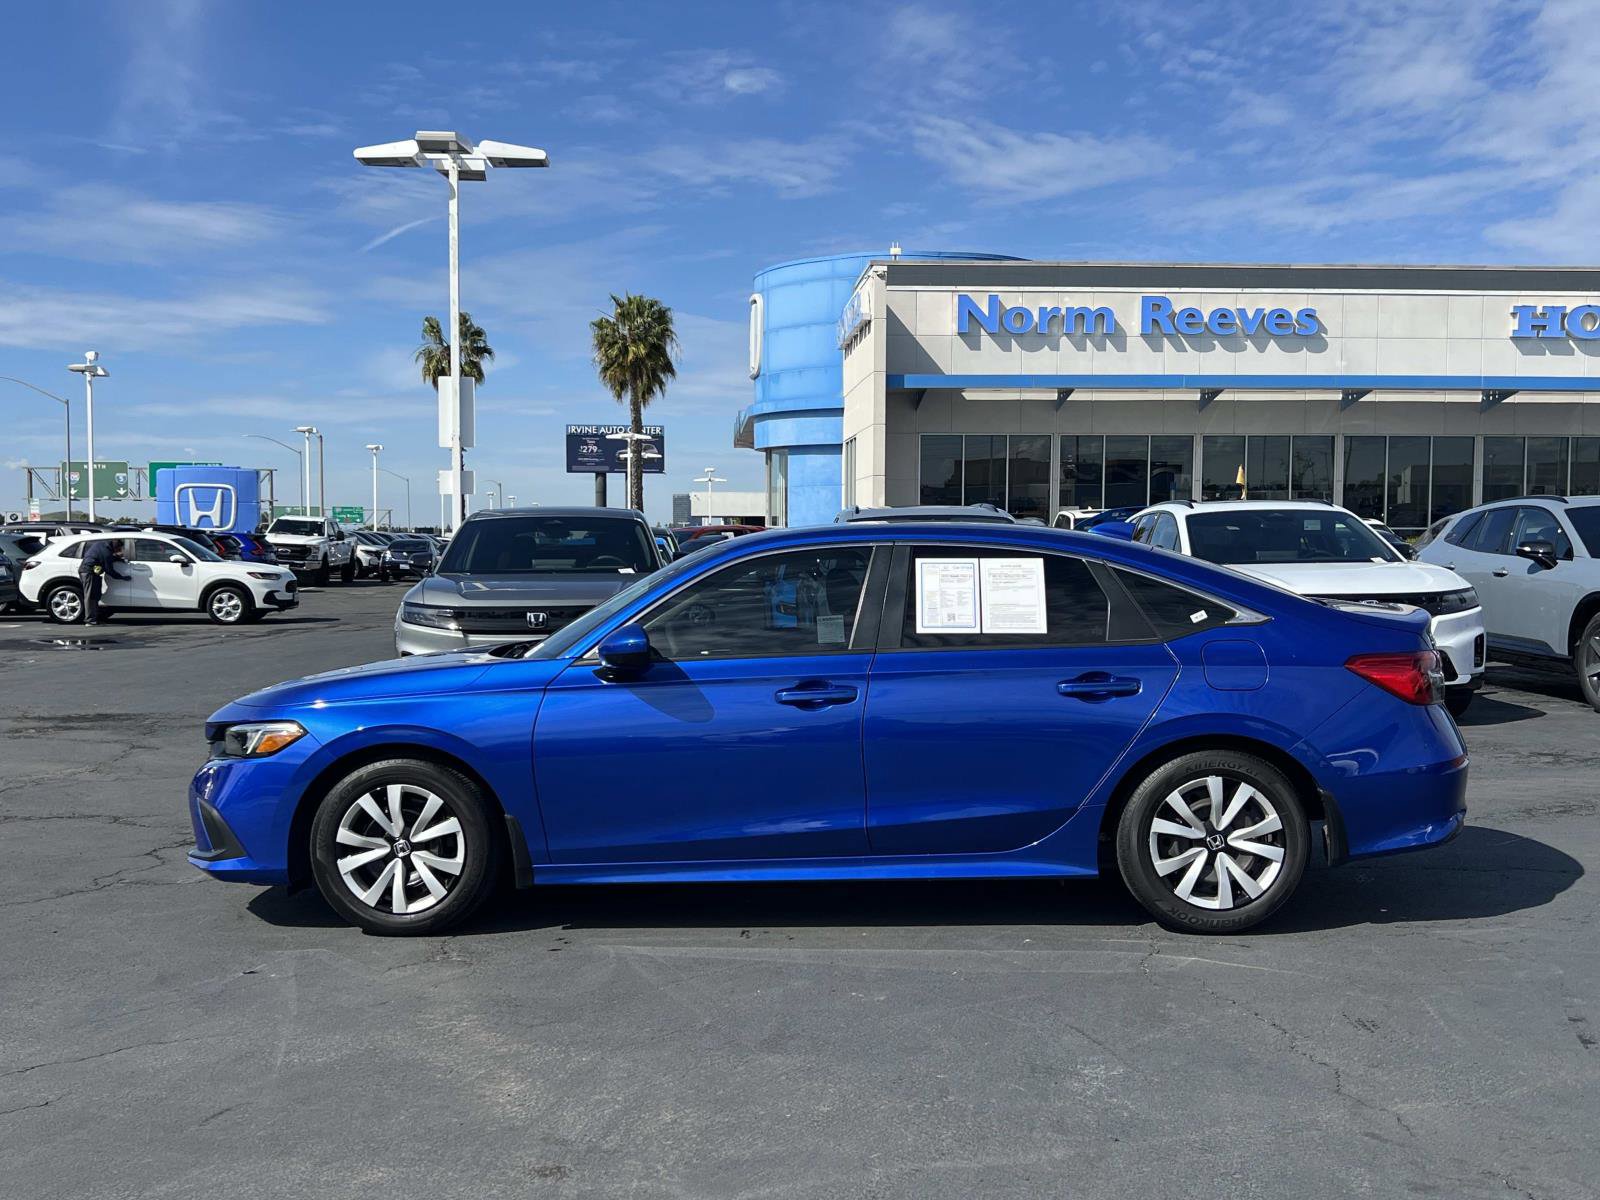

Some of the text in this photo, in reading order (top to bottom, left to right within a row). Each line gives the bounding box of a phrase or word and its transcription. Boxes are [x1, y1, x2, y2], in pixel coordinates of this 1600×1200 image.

[957, 294, 1320, 336] Norm Reeves
[1512, 304, 1600, 340] HO
[568, 425, 661, 435] IRVINE AUTO CNTER
